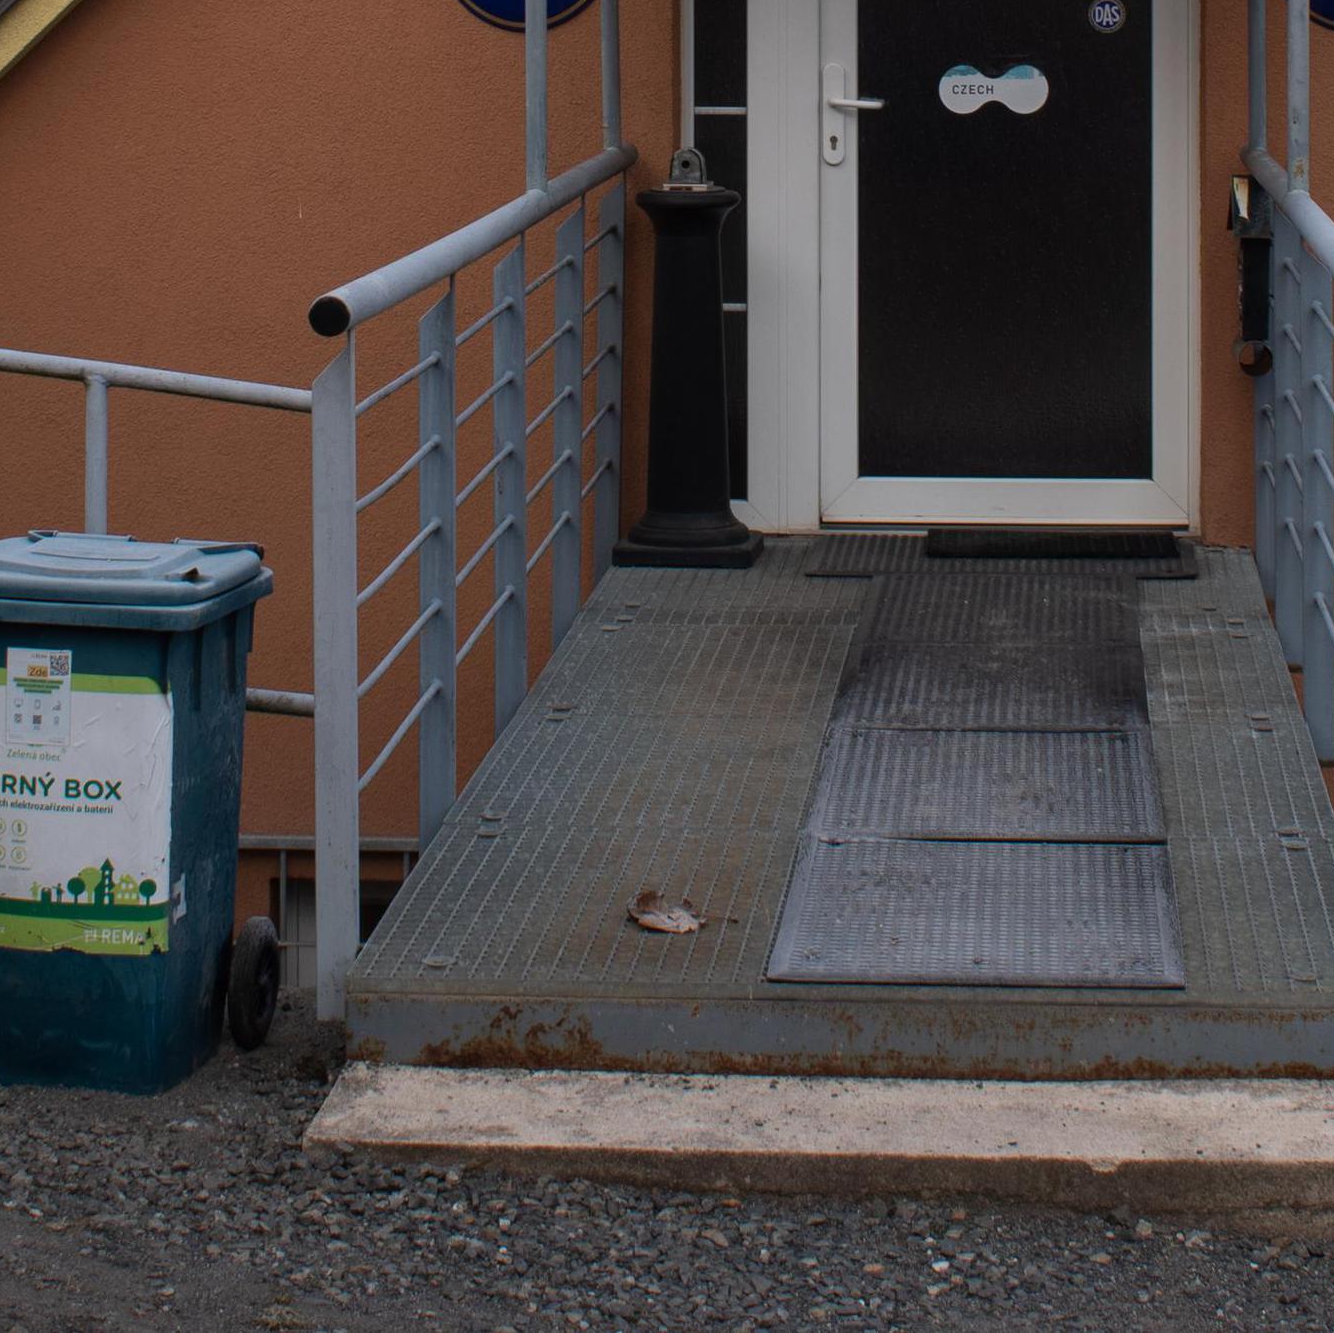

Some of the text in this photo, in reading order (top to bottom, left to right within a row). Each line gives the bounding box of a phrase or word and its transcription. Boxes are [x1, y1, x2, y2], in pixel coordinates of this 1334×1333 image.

[1095, 4, 1120, 26] DAS
[952, 84, 994, 95] CZECH
[6, 748, 37, 760] Zelená
[64, 778, 123, 801] BOX
[102, 928, 146, 945] REMA
